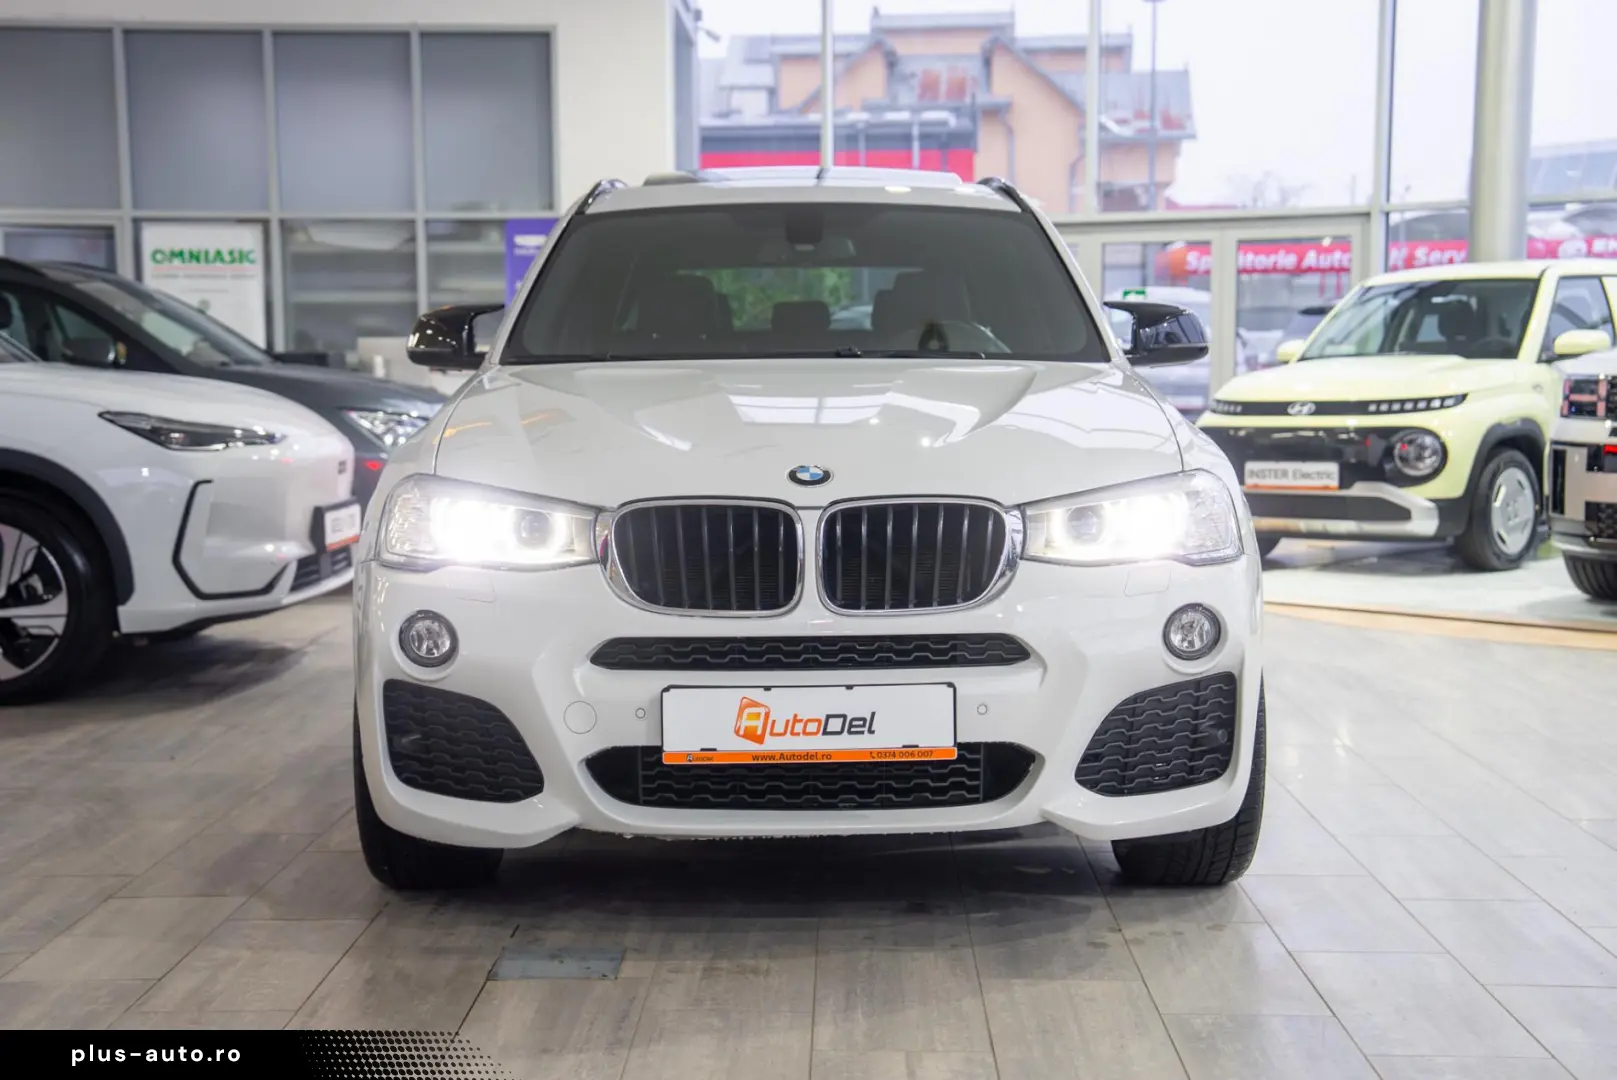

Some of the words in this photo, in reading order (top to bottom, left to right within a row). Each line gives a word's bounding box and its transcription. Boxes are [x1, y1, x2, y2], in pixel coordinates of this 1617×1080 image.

[150, 248, 256, 264] OMNIASIC
[1292, 468, 1337, 481] Electric
[735, 699, 876, 741] AutoDel
[752, 752, 832, 762] www.Autodel.ro
[877, 751, 896, 759] 0374
[898, 750, 915, 758] 006
[917, 750, 933, 758] 007
